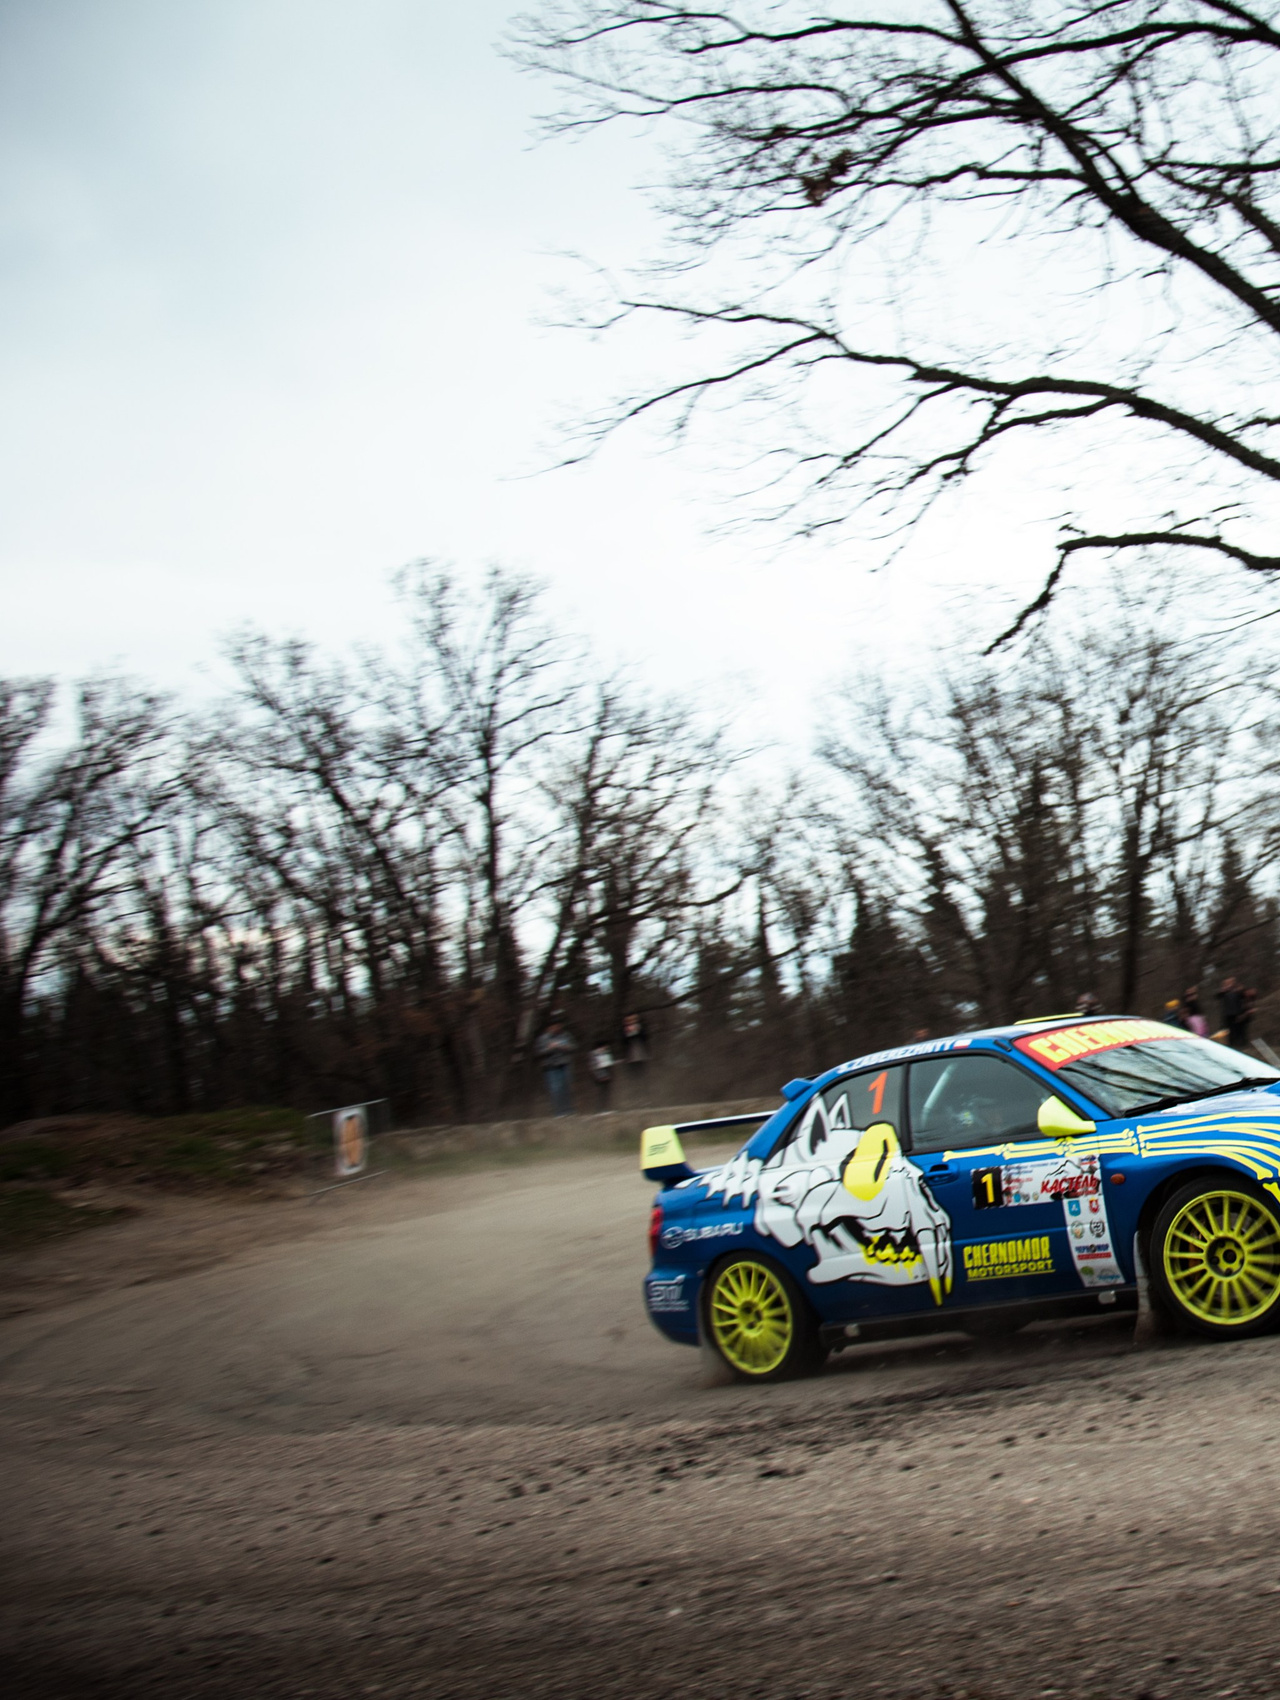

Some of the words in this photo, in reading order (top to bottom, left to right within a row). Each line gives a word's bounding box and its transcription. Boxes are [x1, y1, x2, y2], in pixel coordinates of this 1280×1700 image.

[868, 1071, 888, 1115] 1
[981, 1172, 996, 1204] 1
[684, 1221, 744, 1242] SUBARU
[963, 1236, 1051, 1269] CHERNOMOR
[967, 1259, 1054, 1278] MOTORSPORT
